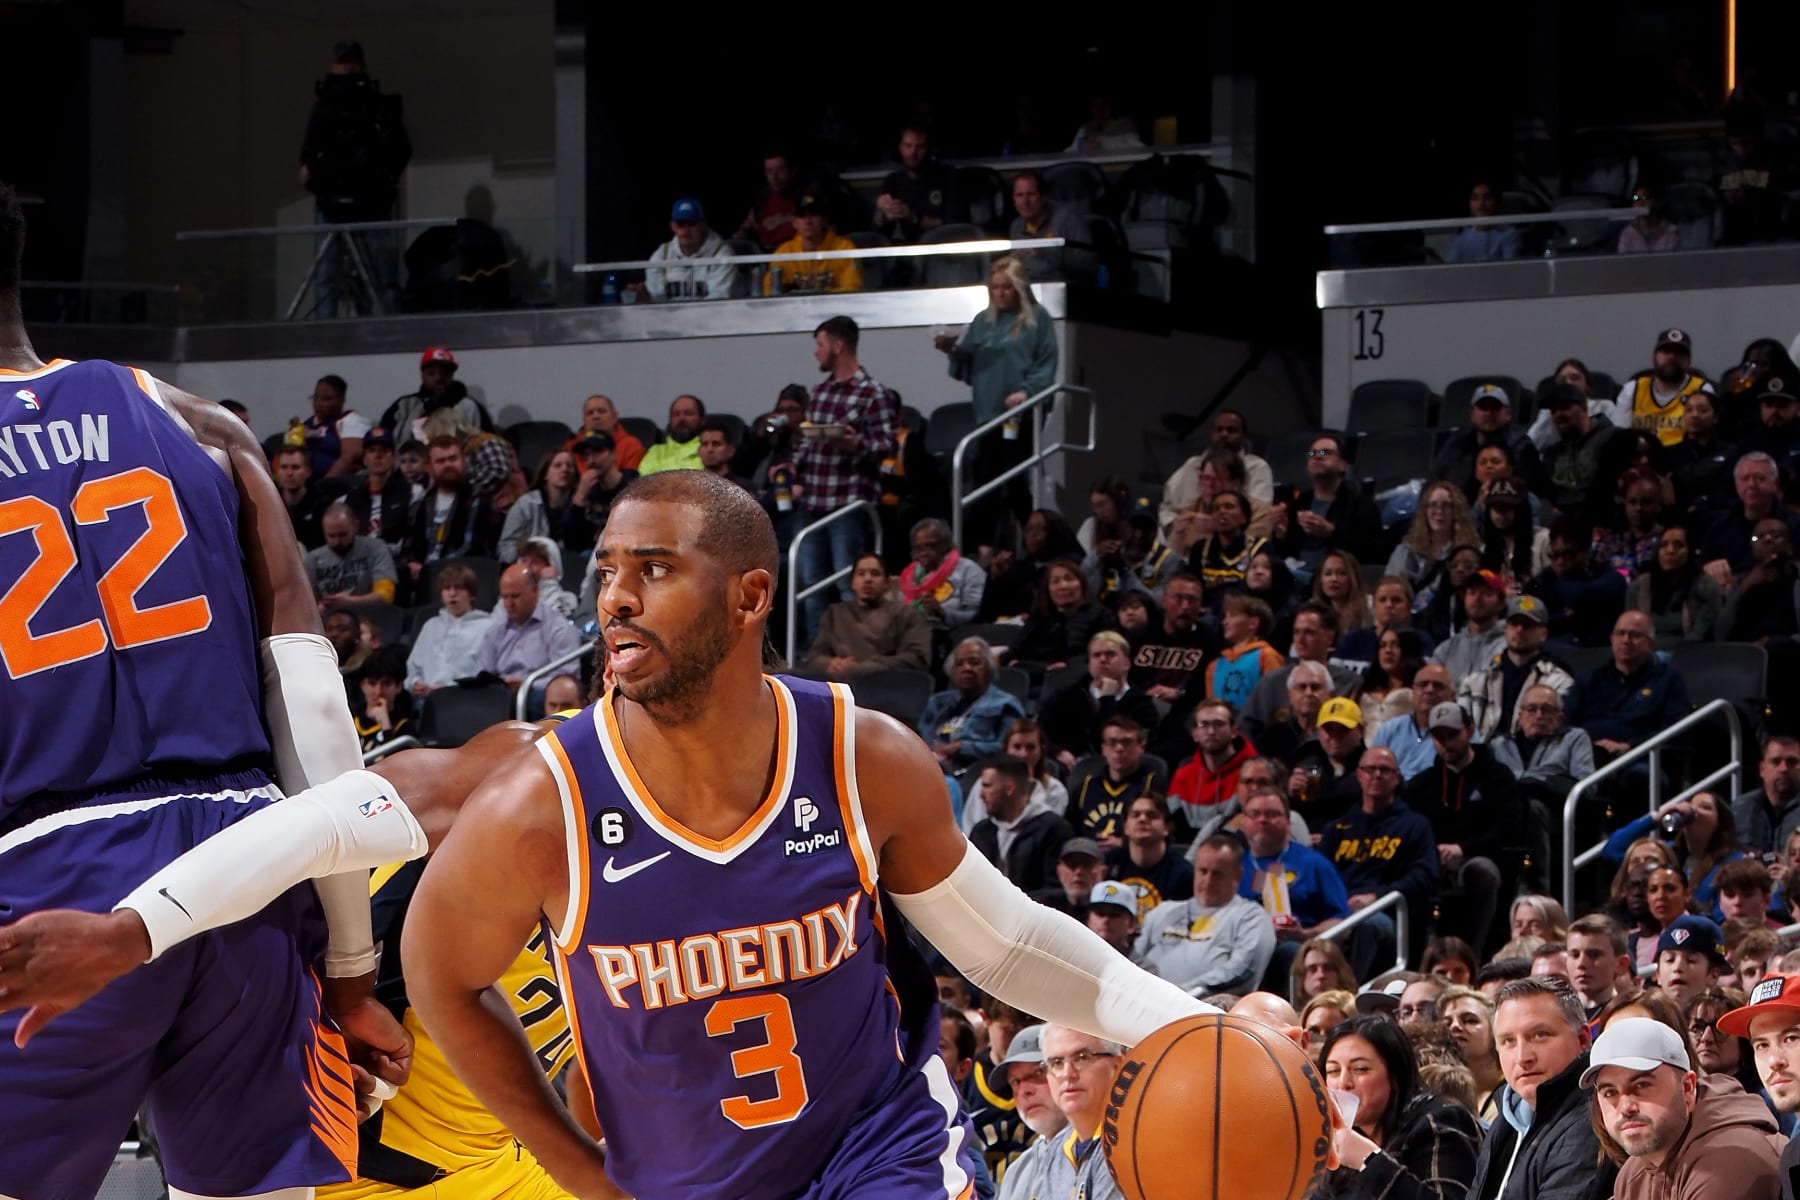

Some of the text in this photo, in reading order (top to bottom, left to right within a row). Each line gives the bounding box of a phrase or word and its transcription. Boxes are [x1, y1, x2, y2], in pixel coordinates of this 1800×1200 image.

[1354, 309, 1384, 361] 13
[0, 466, 213, 680] 22
[1133, 644, 1203, 671] SUNS
[601, 813, 625, 845] 6
[784, 829, 840, 857] PayPal
[587, 890, 862, 1010] PHOENIX
[704, 992, 809, 1131] 3
